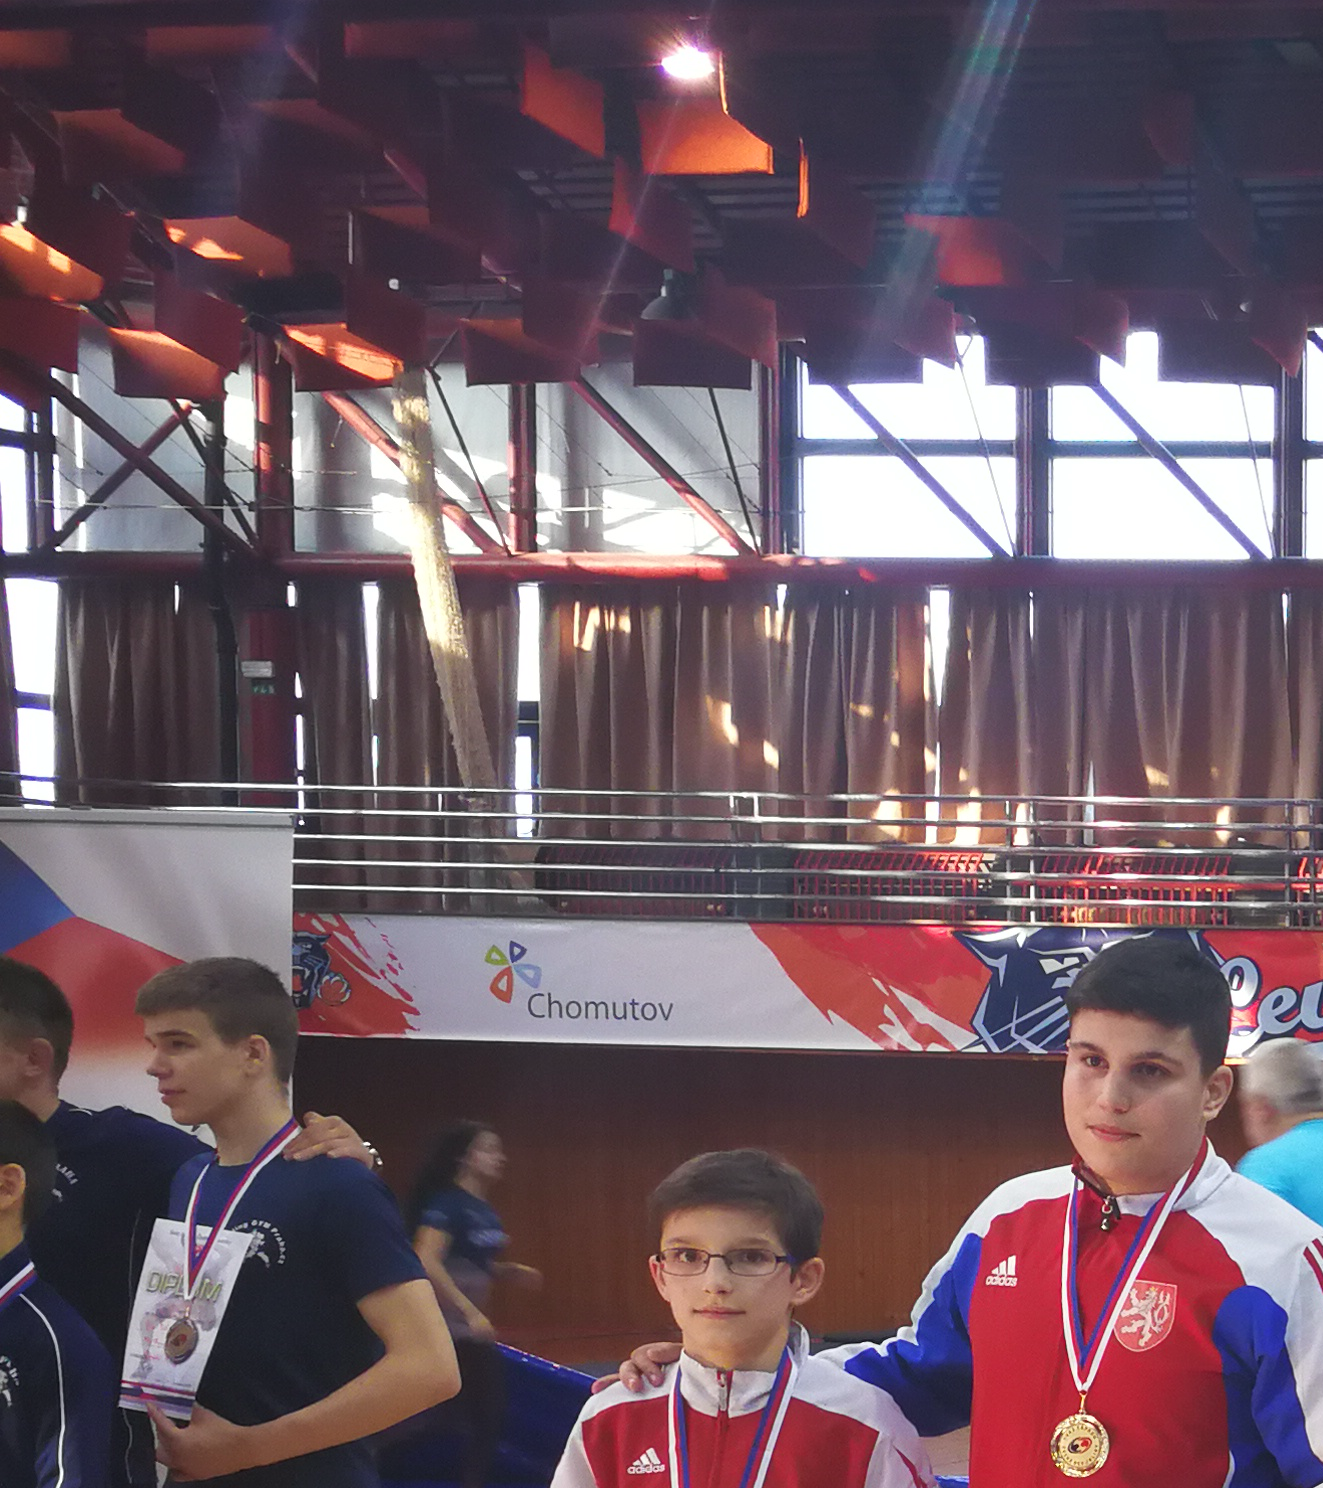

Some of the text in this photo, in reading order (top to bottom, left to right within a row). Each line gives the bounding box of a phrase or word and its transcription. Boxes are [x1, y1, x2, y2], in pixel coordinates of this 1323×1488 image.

[527, 992, 674, 1021] Chomutov
[145, 1272, 223, 1301] DIPLM
[985, 1275, 1018, 1287] adidas
[627, 1464, 665, 1475] adidas
